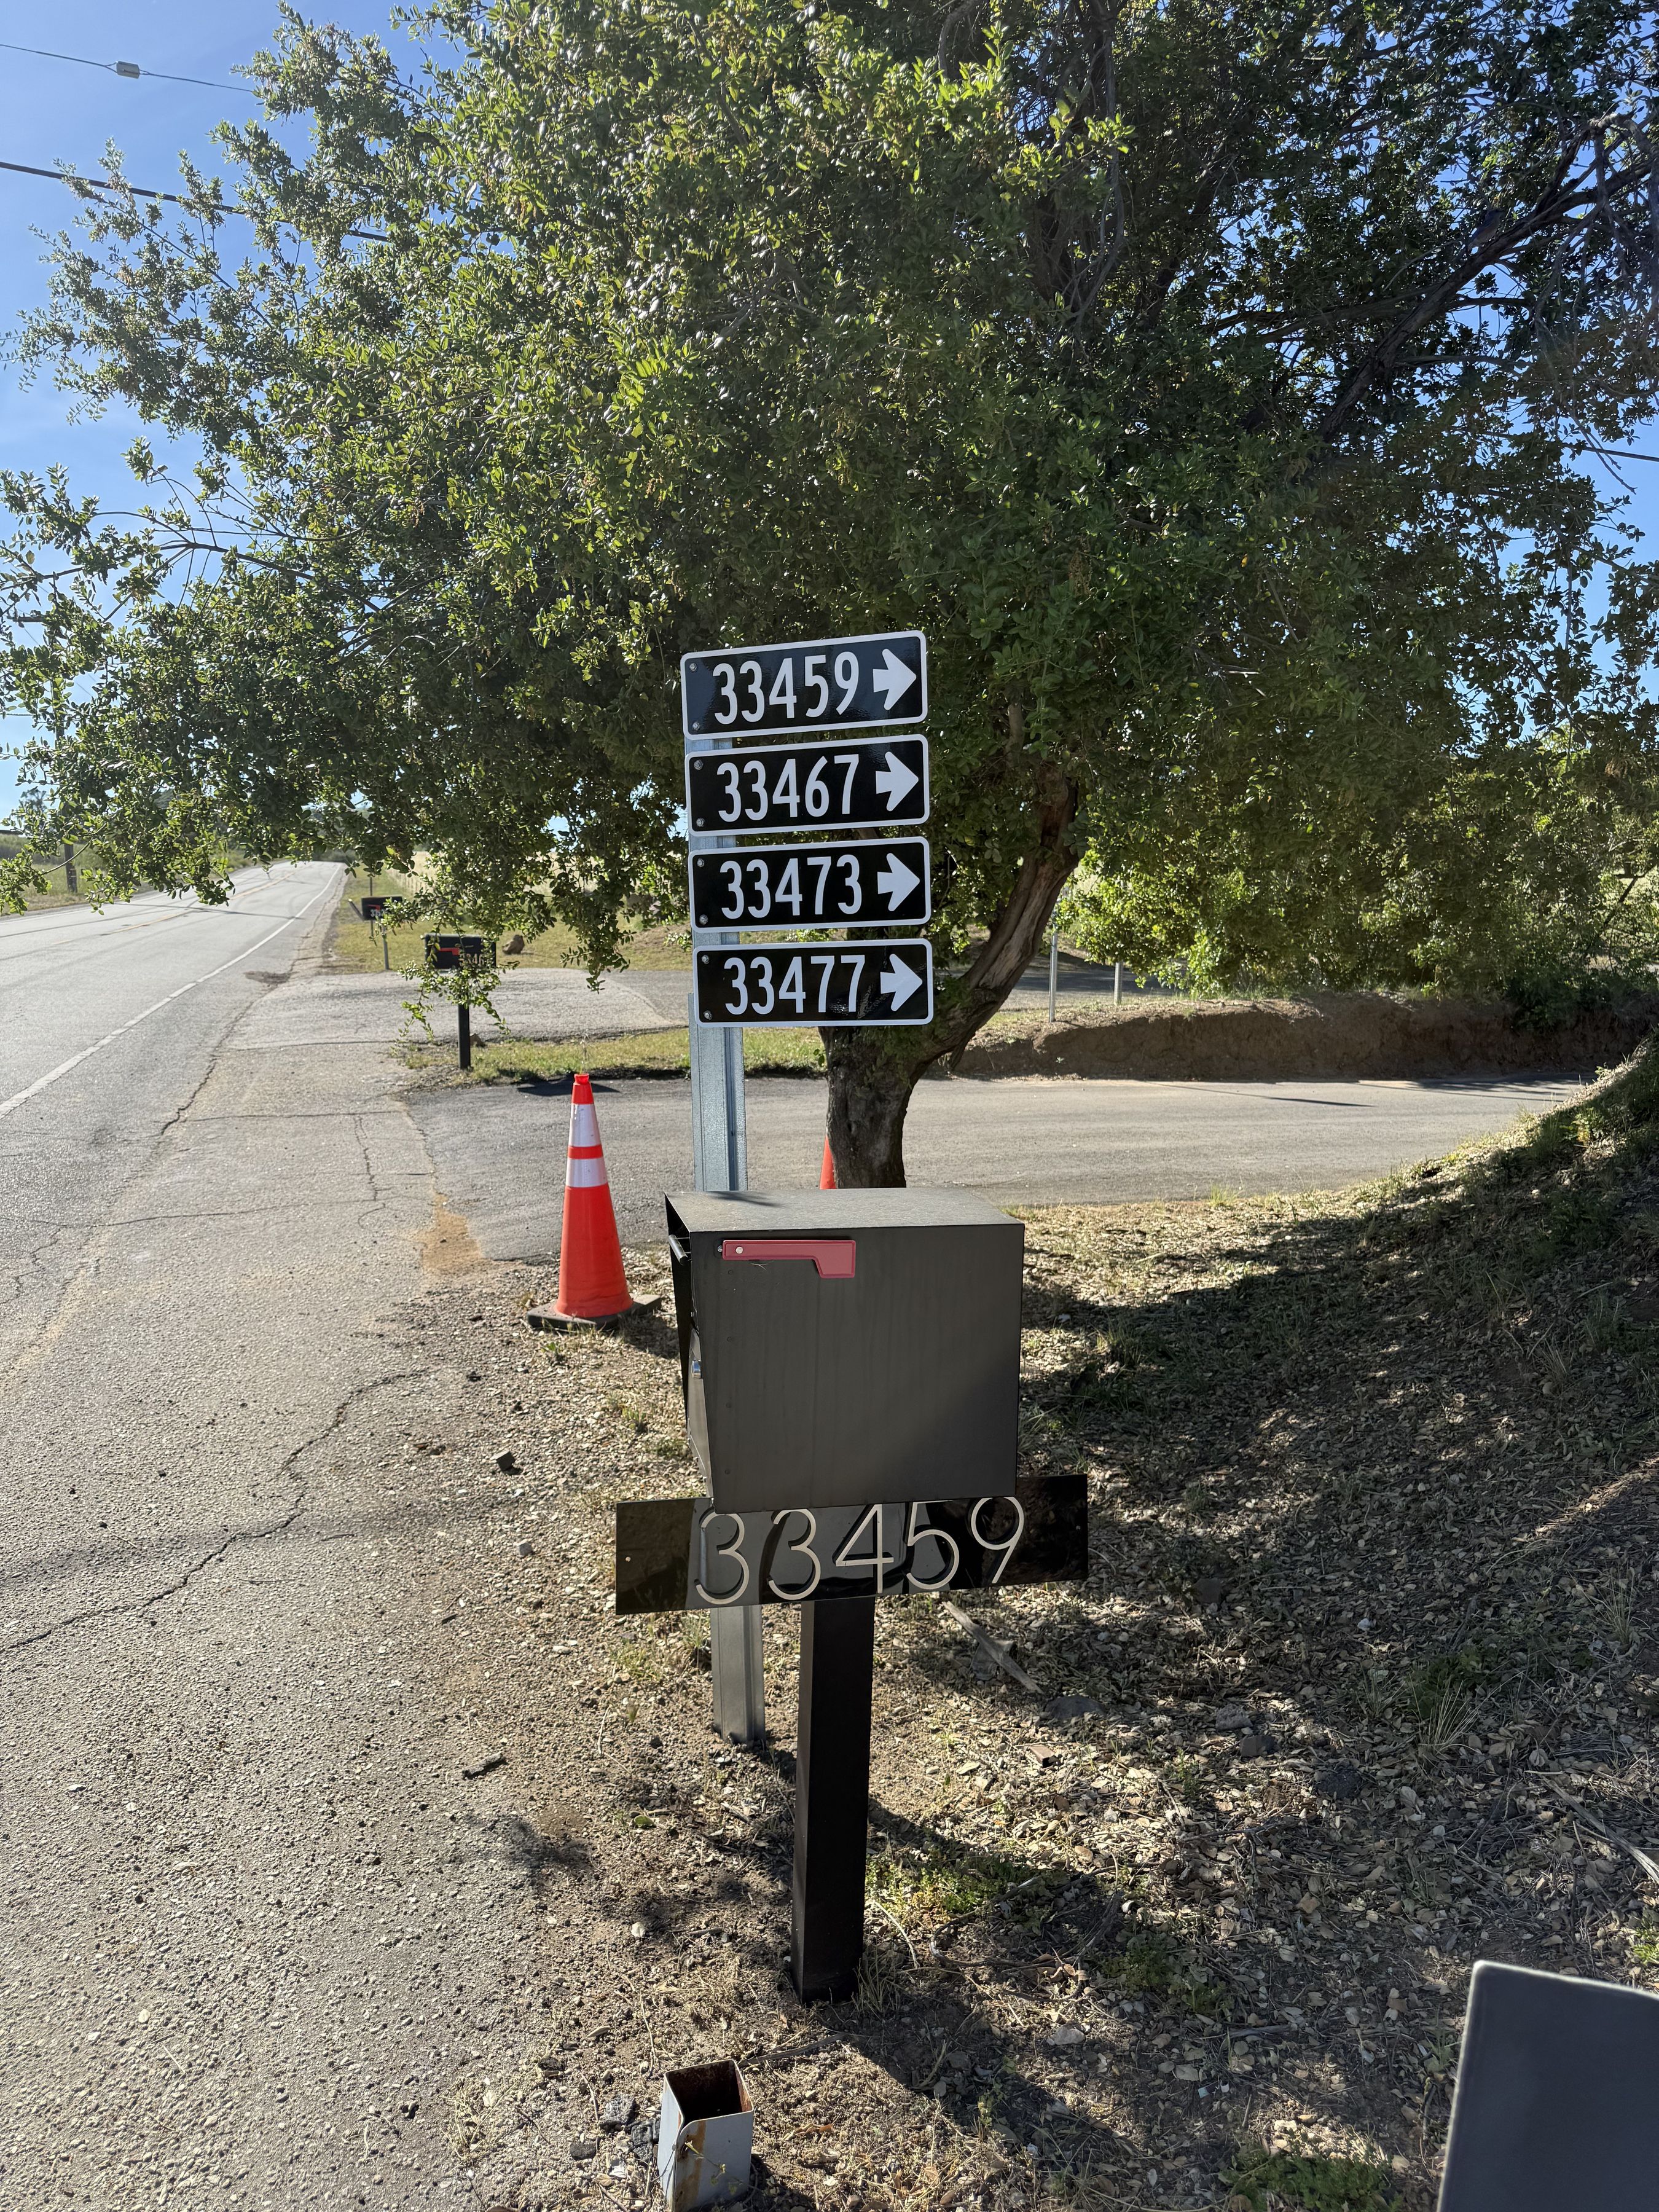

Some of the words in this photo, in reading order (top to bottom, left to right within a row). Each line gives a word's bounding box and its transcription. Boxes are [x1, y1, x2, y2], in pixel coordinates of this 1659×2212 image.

[713, 652, 858, 724] 33459
[716, 754, 858, 822] 33467
[720, 855, 861, 919] 33473
[724, 955, 865, 1014] 33477
[696, 1496, 1024, 1605] 33459
